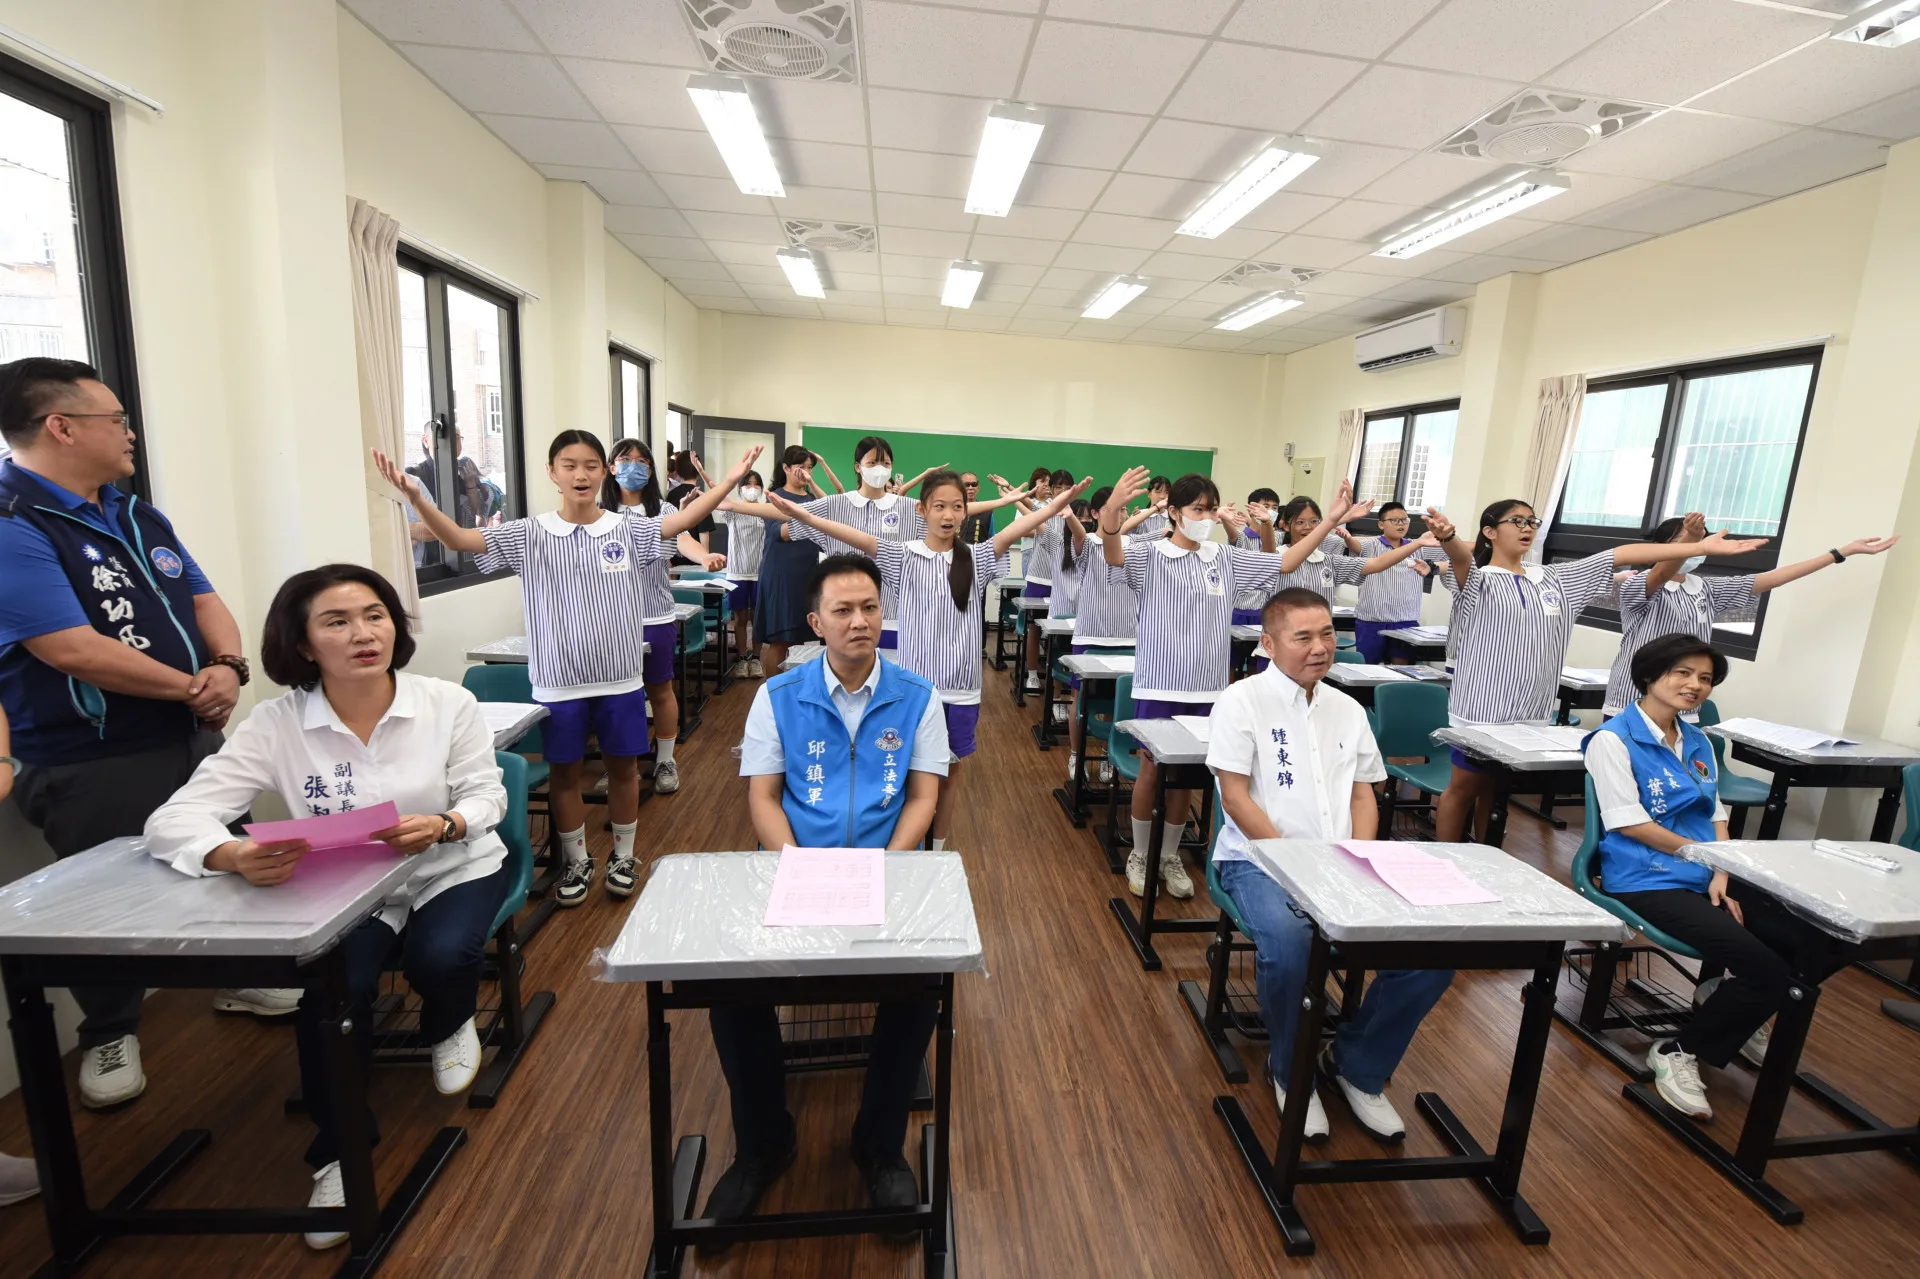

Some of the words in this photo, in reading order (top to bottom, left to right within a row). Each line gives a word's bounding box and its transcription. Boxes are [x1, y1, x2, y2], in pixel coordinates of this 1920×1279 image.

[333, 762, 356, 812] 副議長
[805, 740, 826, 806] 邱鎮軍
[881, 753, 898, 809] 立法委員
[1271, 728, 1294, 790] 鍾東錦
